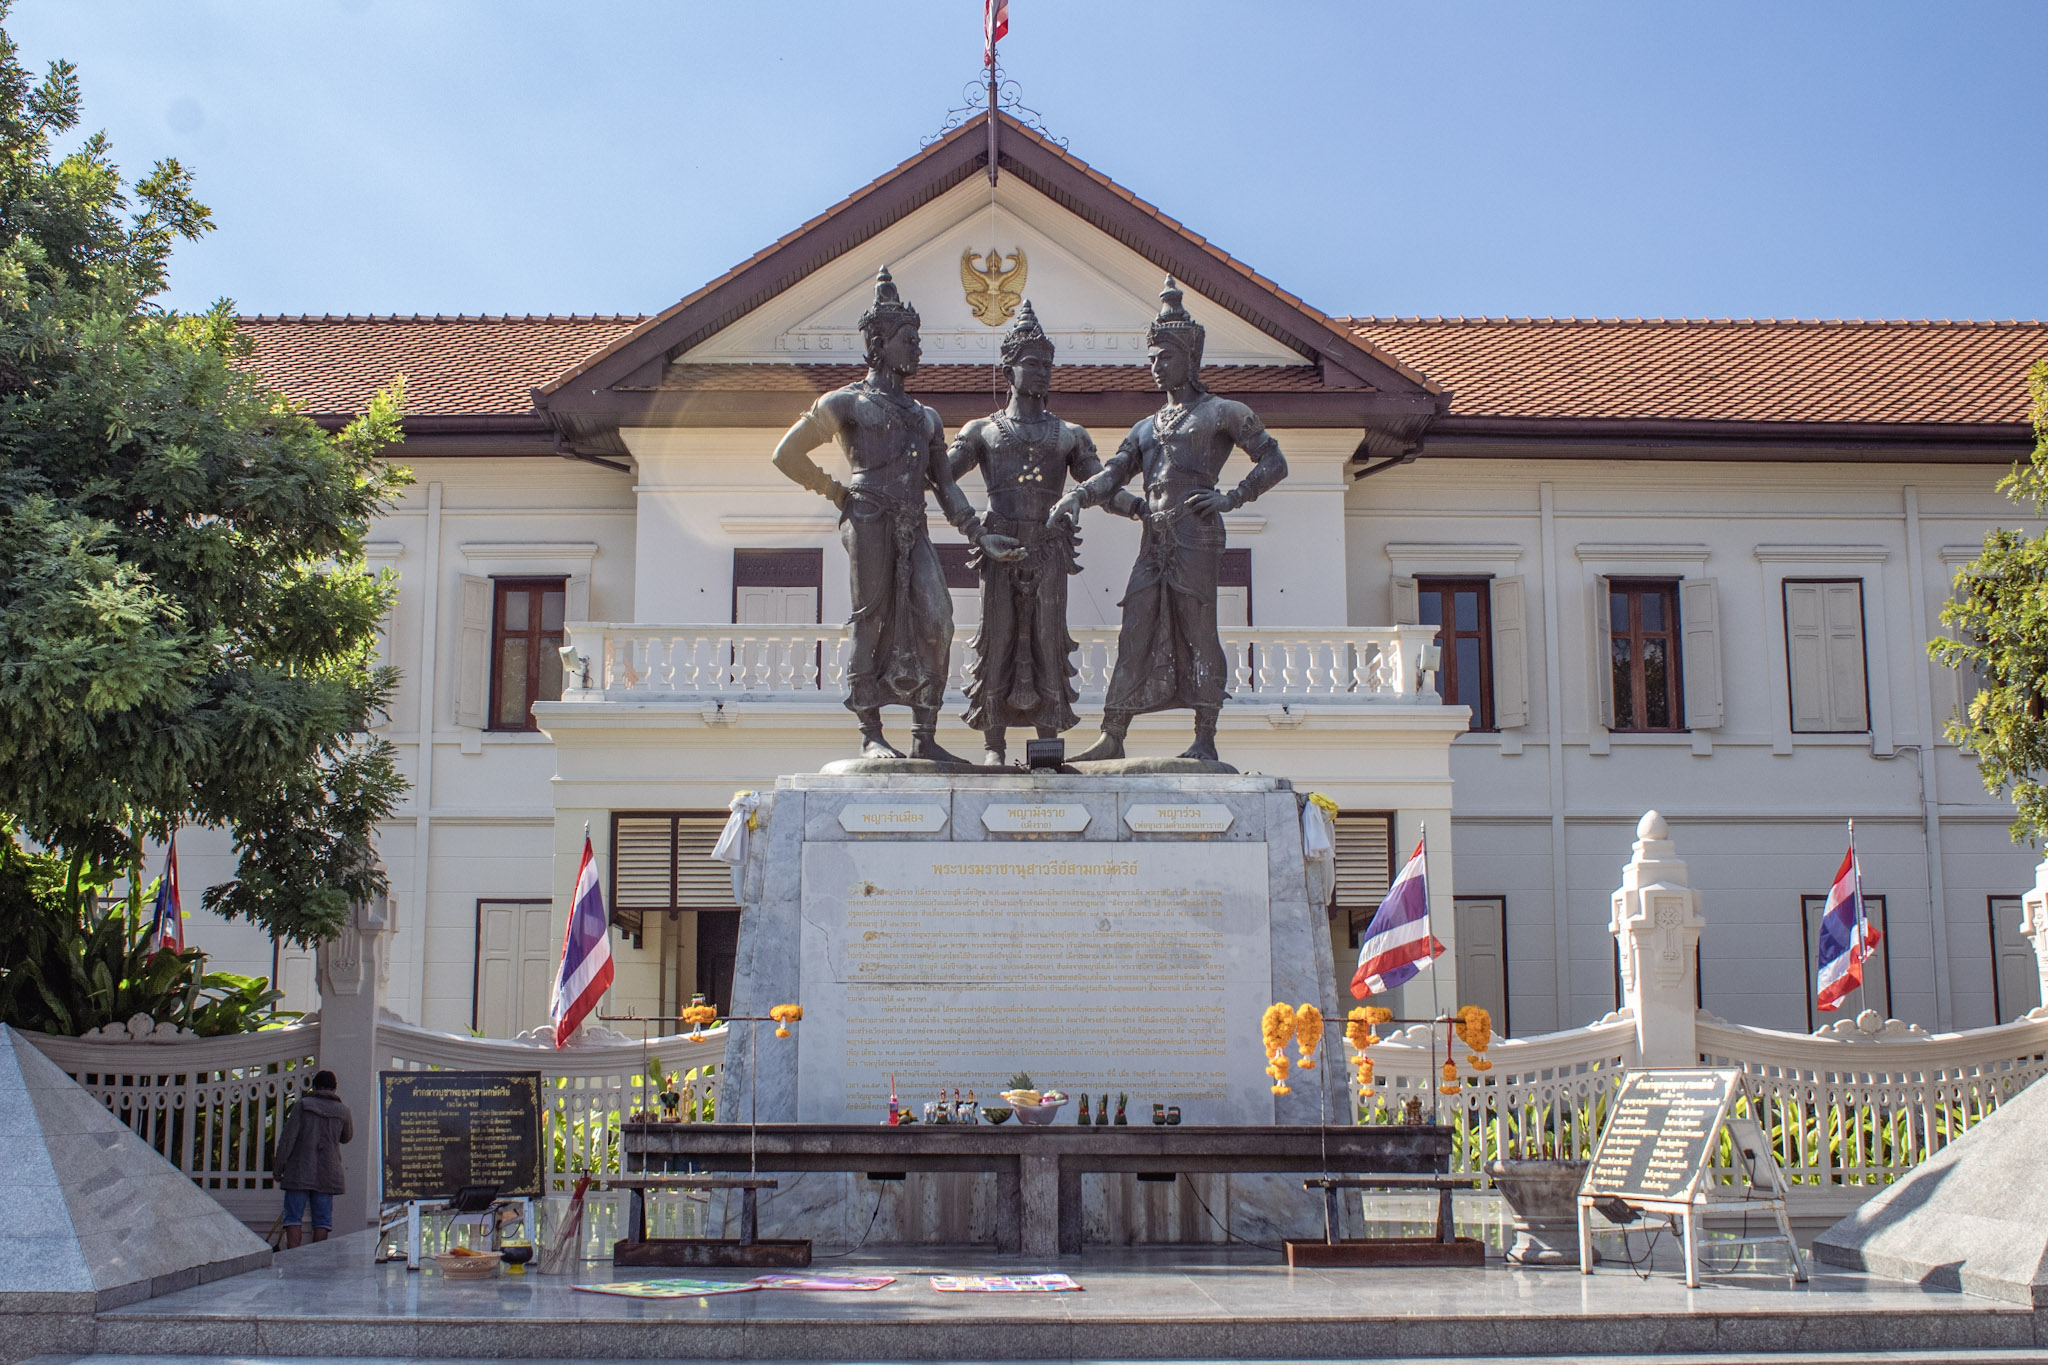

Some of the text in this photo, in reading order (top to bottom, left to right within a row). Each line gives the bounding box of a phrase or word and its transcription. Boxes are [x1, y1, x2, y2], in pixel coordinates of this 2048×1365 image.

[862, 810, 924, 825] พญางำเมือง
[1008, 806, 1065, 820] พญามังราย
[1157, 806, 1201, 820] พญาร่วง
[931, 860, 1138, 879] พระบรมราชานุสาวรีย์สามกษัตริย์
